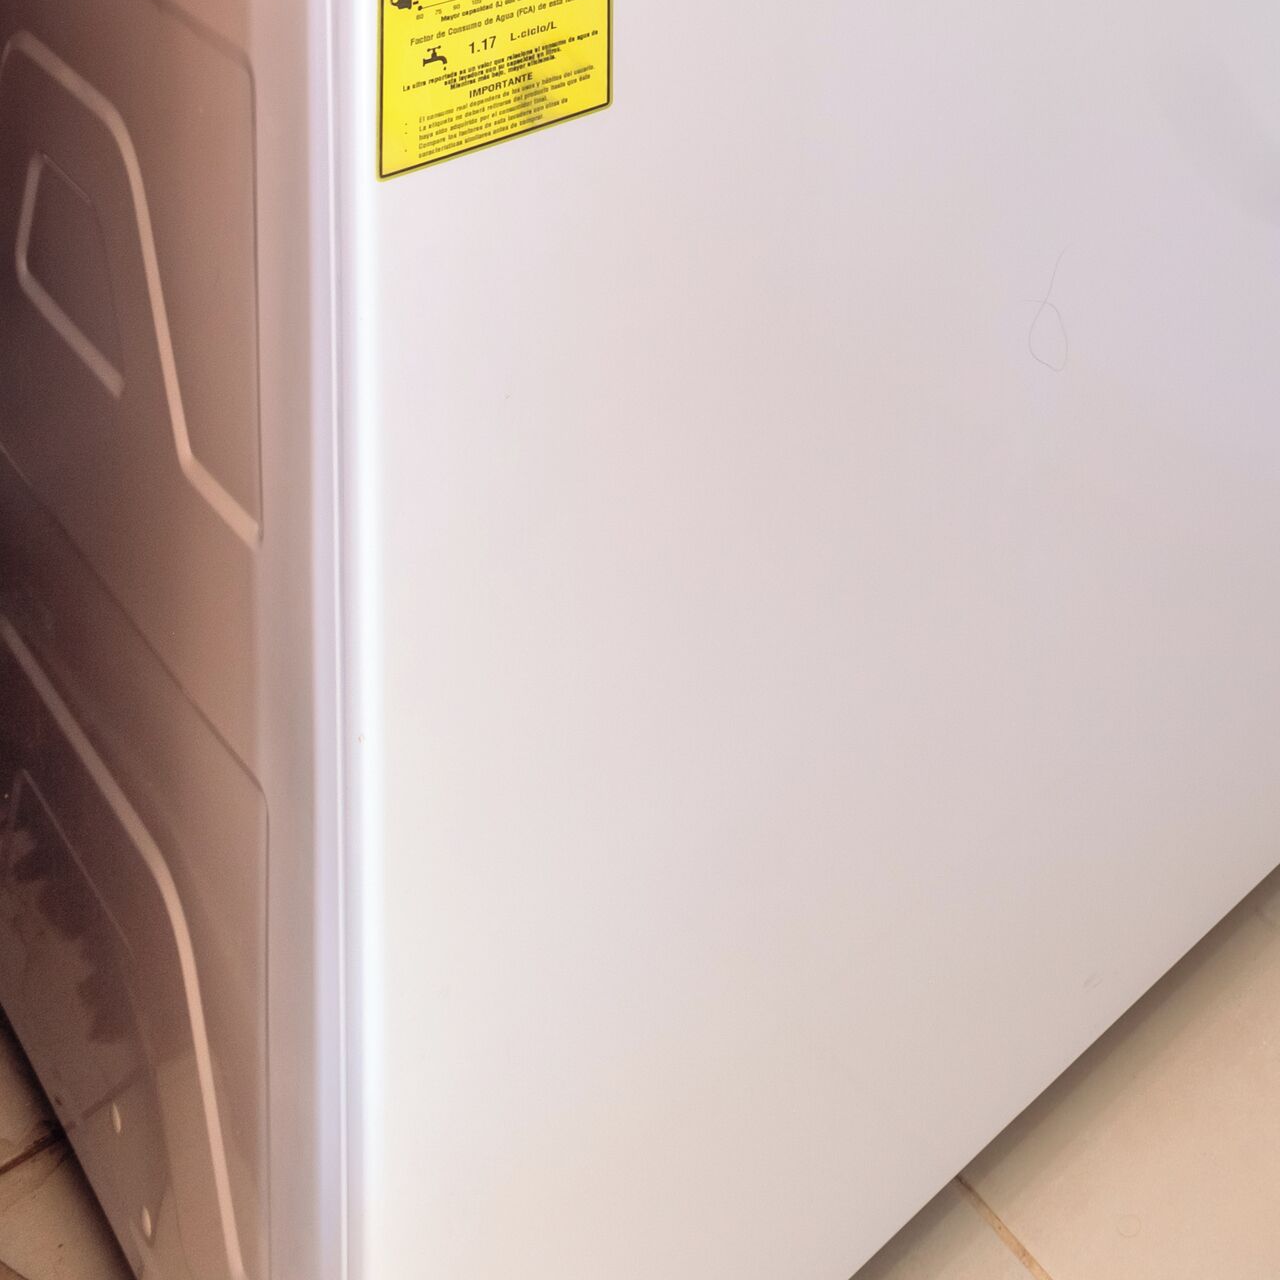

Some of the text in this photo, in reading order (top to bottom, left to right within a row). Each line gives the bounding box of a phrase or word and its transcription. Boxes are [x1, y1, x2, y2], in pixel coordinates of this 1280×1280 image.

[410, 32, 433, 46] Factor
[436, 29, 445, 38] de
[448, 19, 481, 35] Consumo
[484, 16, 493, 25] de
[495, 10, 513, 24] Agua
[516, 4, 535, 17] (FCA)
[537, 1, 546, 10] de
[468, 35, 496, 55] 1.17
[469, 71, 533, 98] IMPORTANTE
